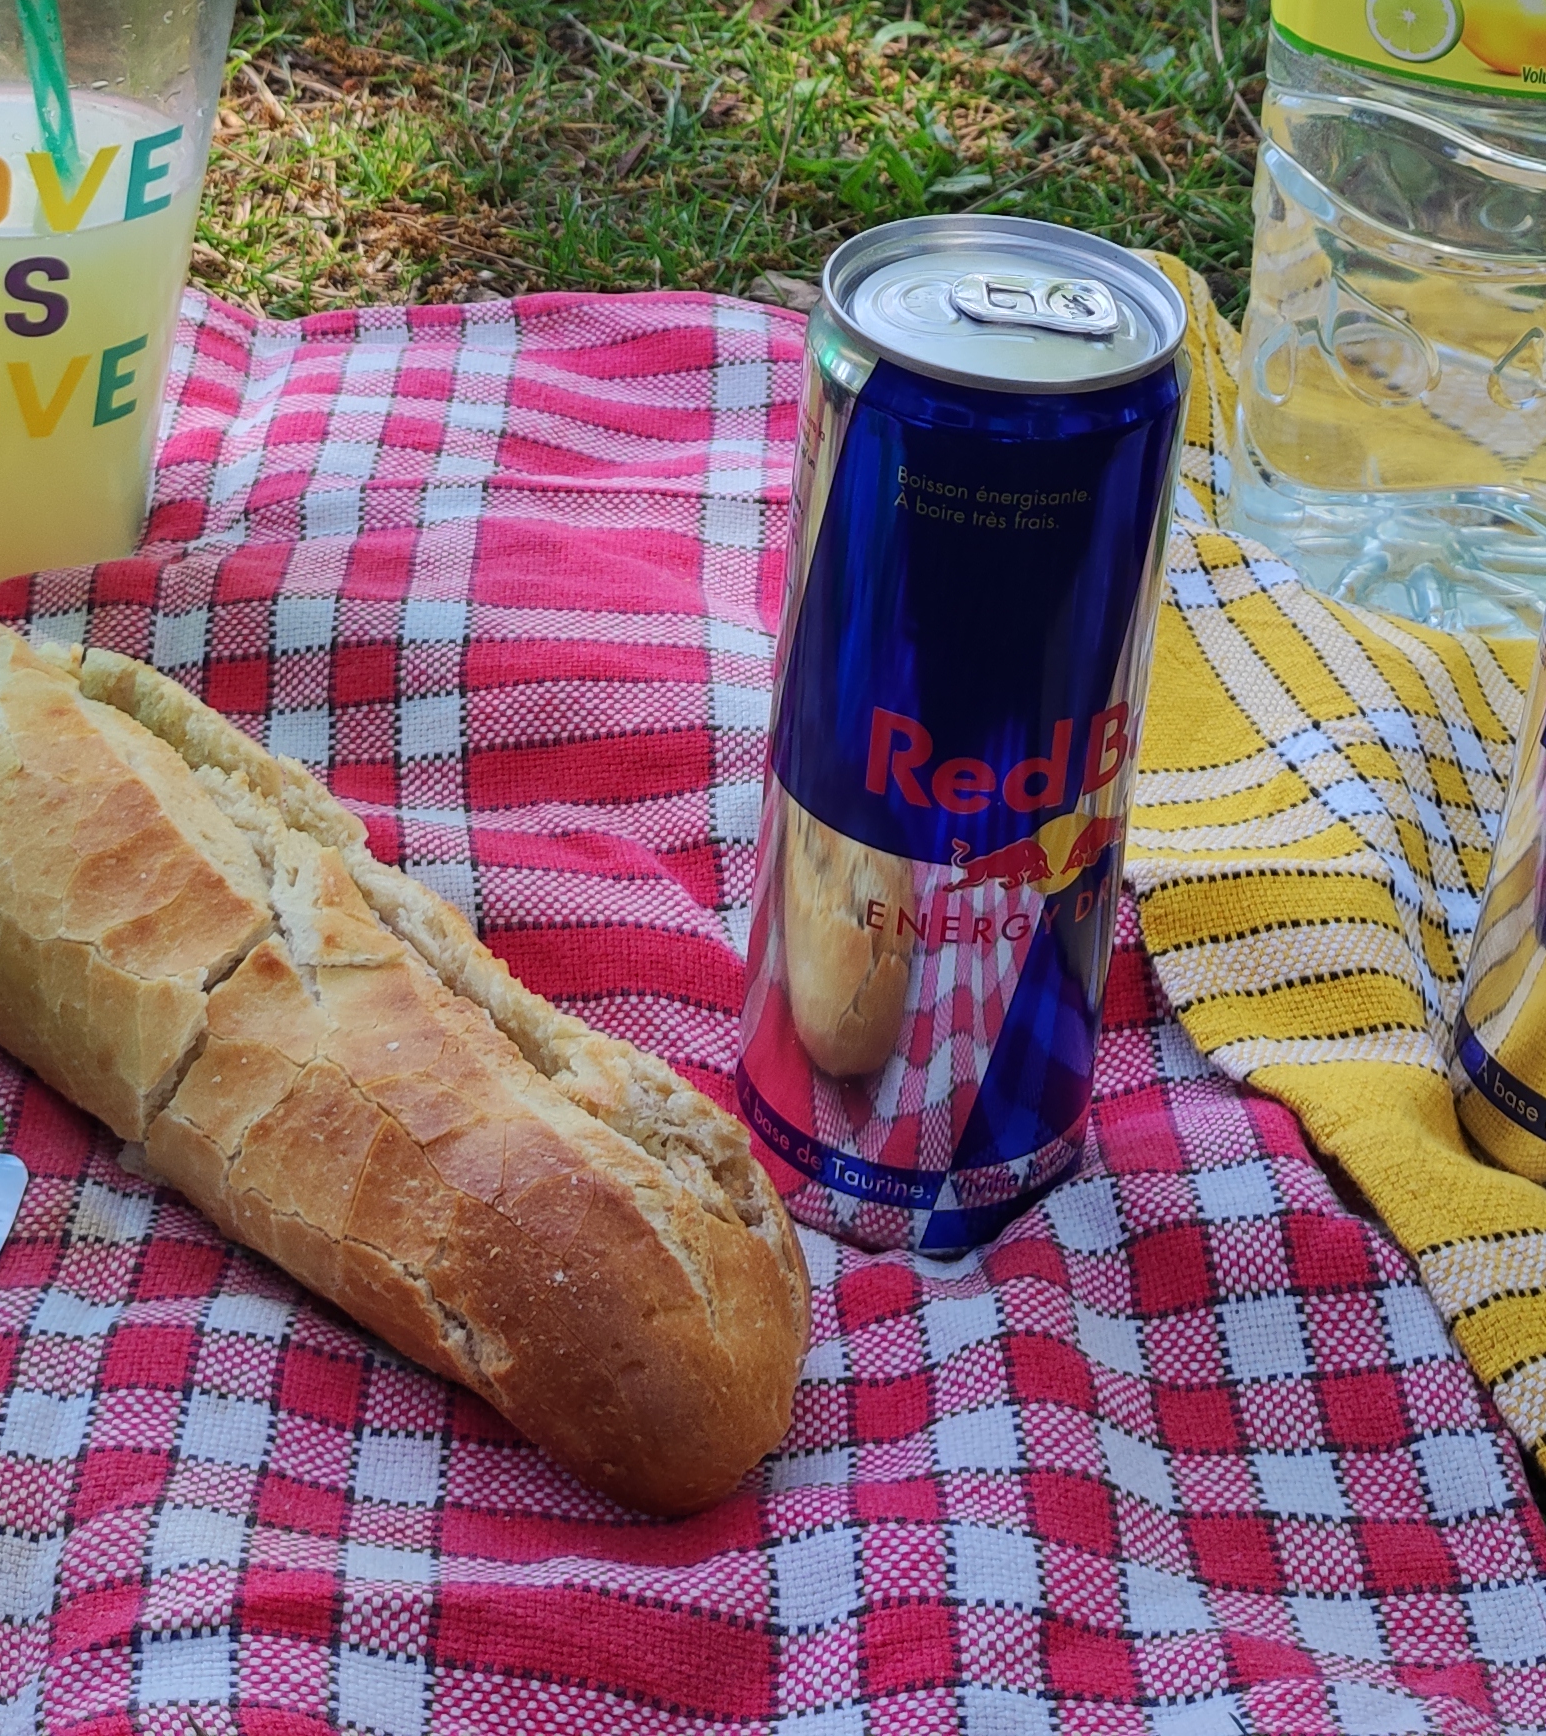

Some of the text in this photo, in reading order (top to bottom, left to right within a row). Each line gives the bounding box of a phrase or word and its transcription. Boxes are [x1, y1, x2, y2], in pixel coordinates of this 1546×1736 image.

[897, 465, 1092, 513] Boisson énergisante.
[915, 498, 966, 525] boire
[972, 510, 1007, 529] très
[1014, 509, 1060, 530] frais.
[865, 706, 1073, 814] Red
[866, 898, 1062, 945] ENERGY
[1493, 1072, 1538, 1122] base
[753, 1102, 791, 1152] base
[796, 1141, 823, 1170] de
[830, 1157, 932, 1200] Taurine.
